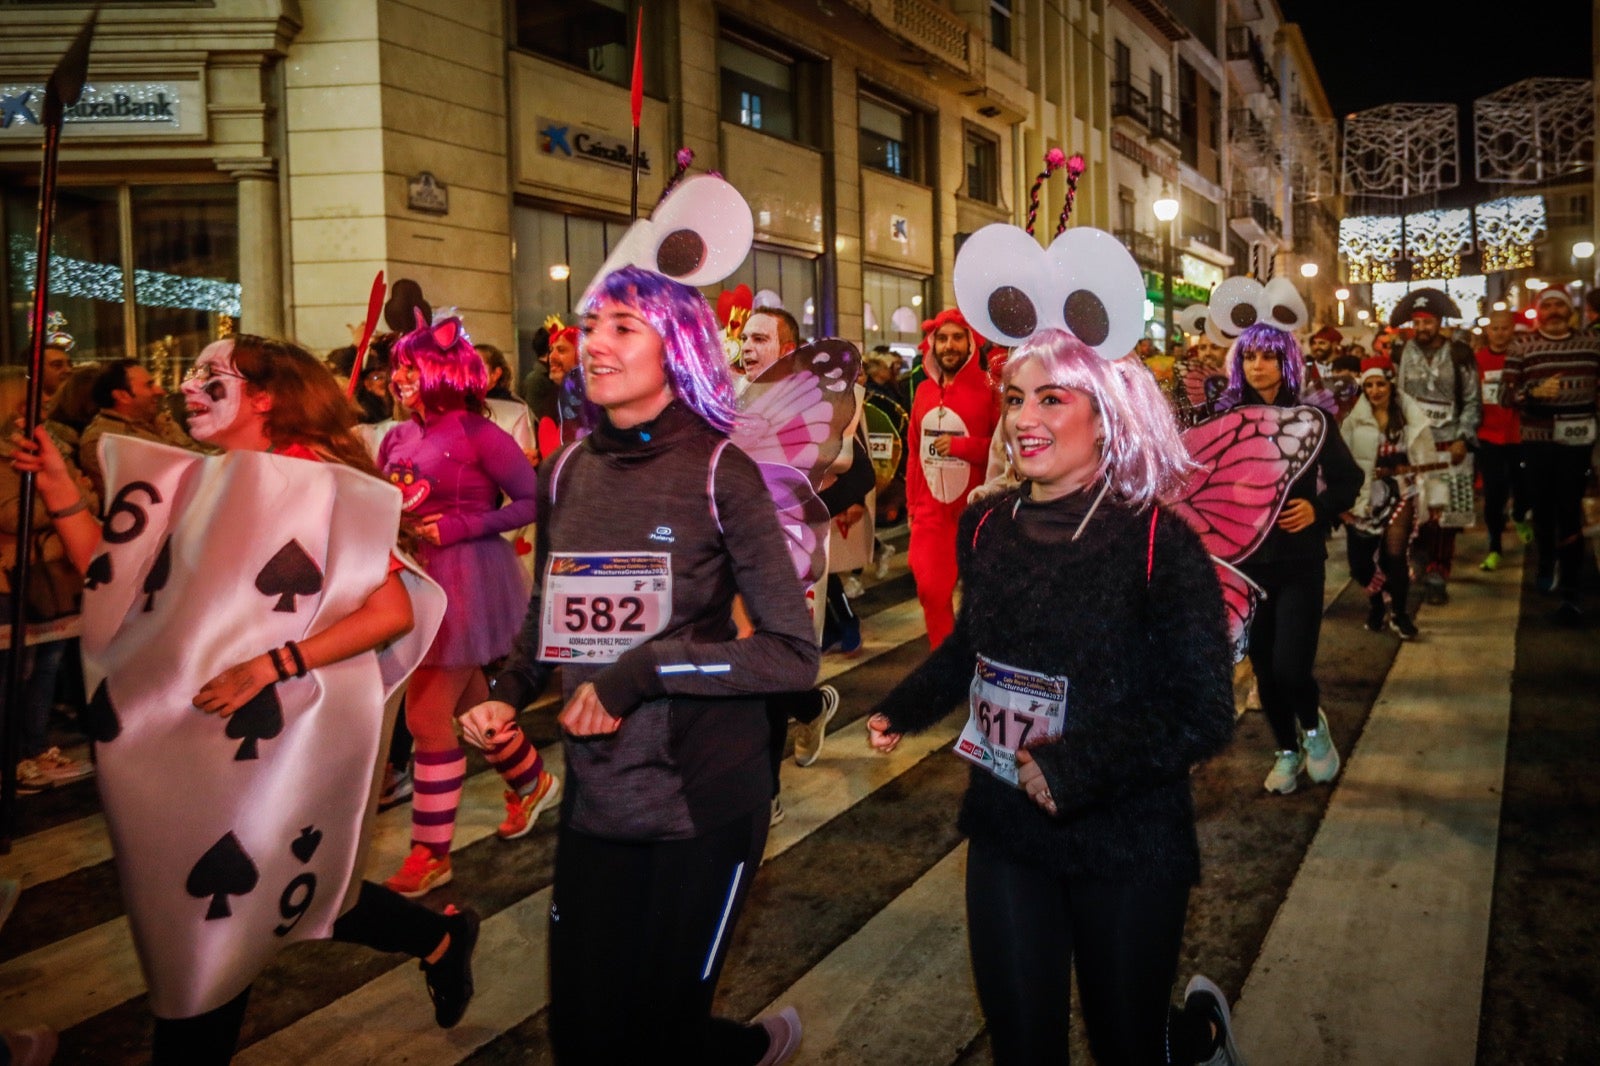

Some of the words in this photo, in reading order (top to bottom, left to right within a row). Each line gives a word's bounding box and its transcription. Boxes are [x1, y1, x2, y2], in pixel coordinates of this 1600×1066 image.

[64, 92, 174, 116] aixaBank
[574, 133, 651, 170] CaixaBak
[102, 481, 163, 544] 6
[565, 596, 646, 633] 582
[979, 700, 1035, 752] 617
